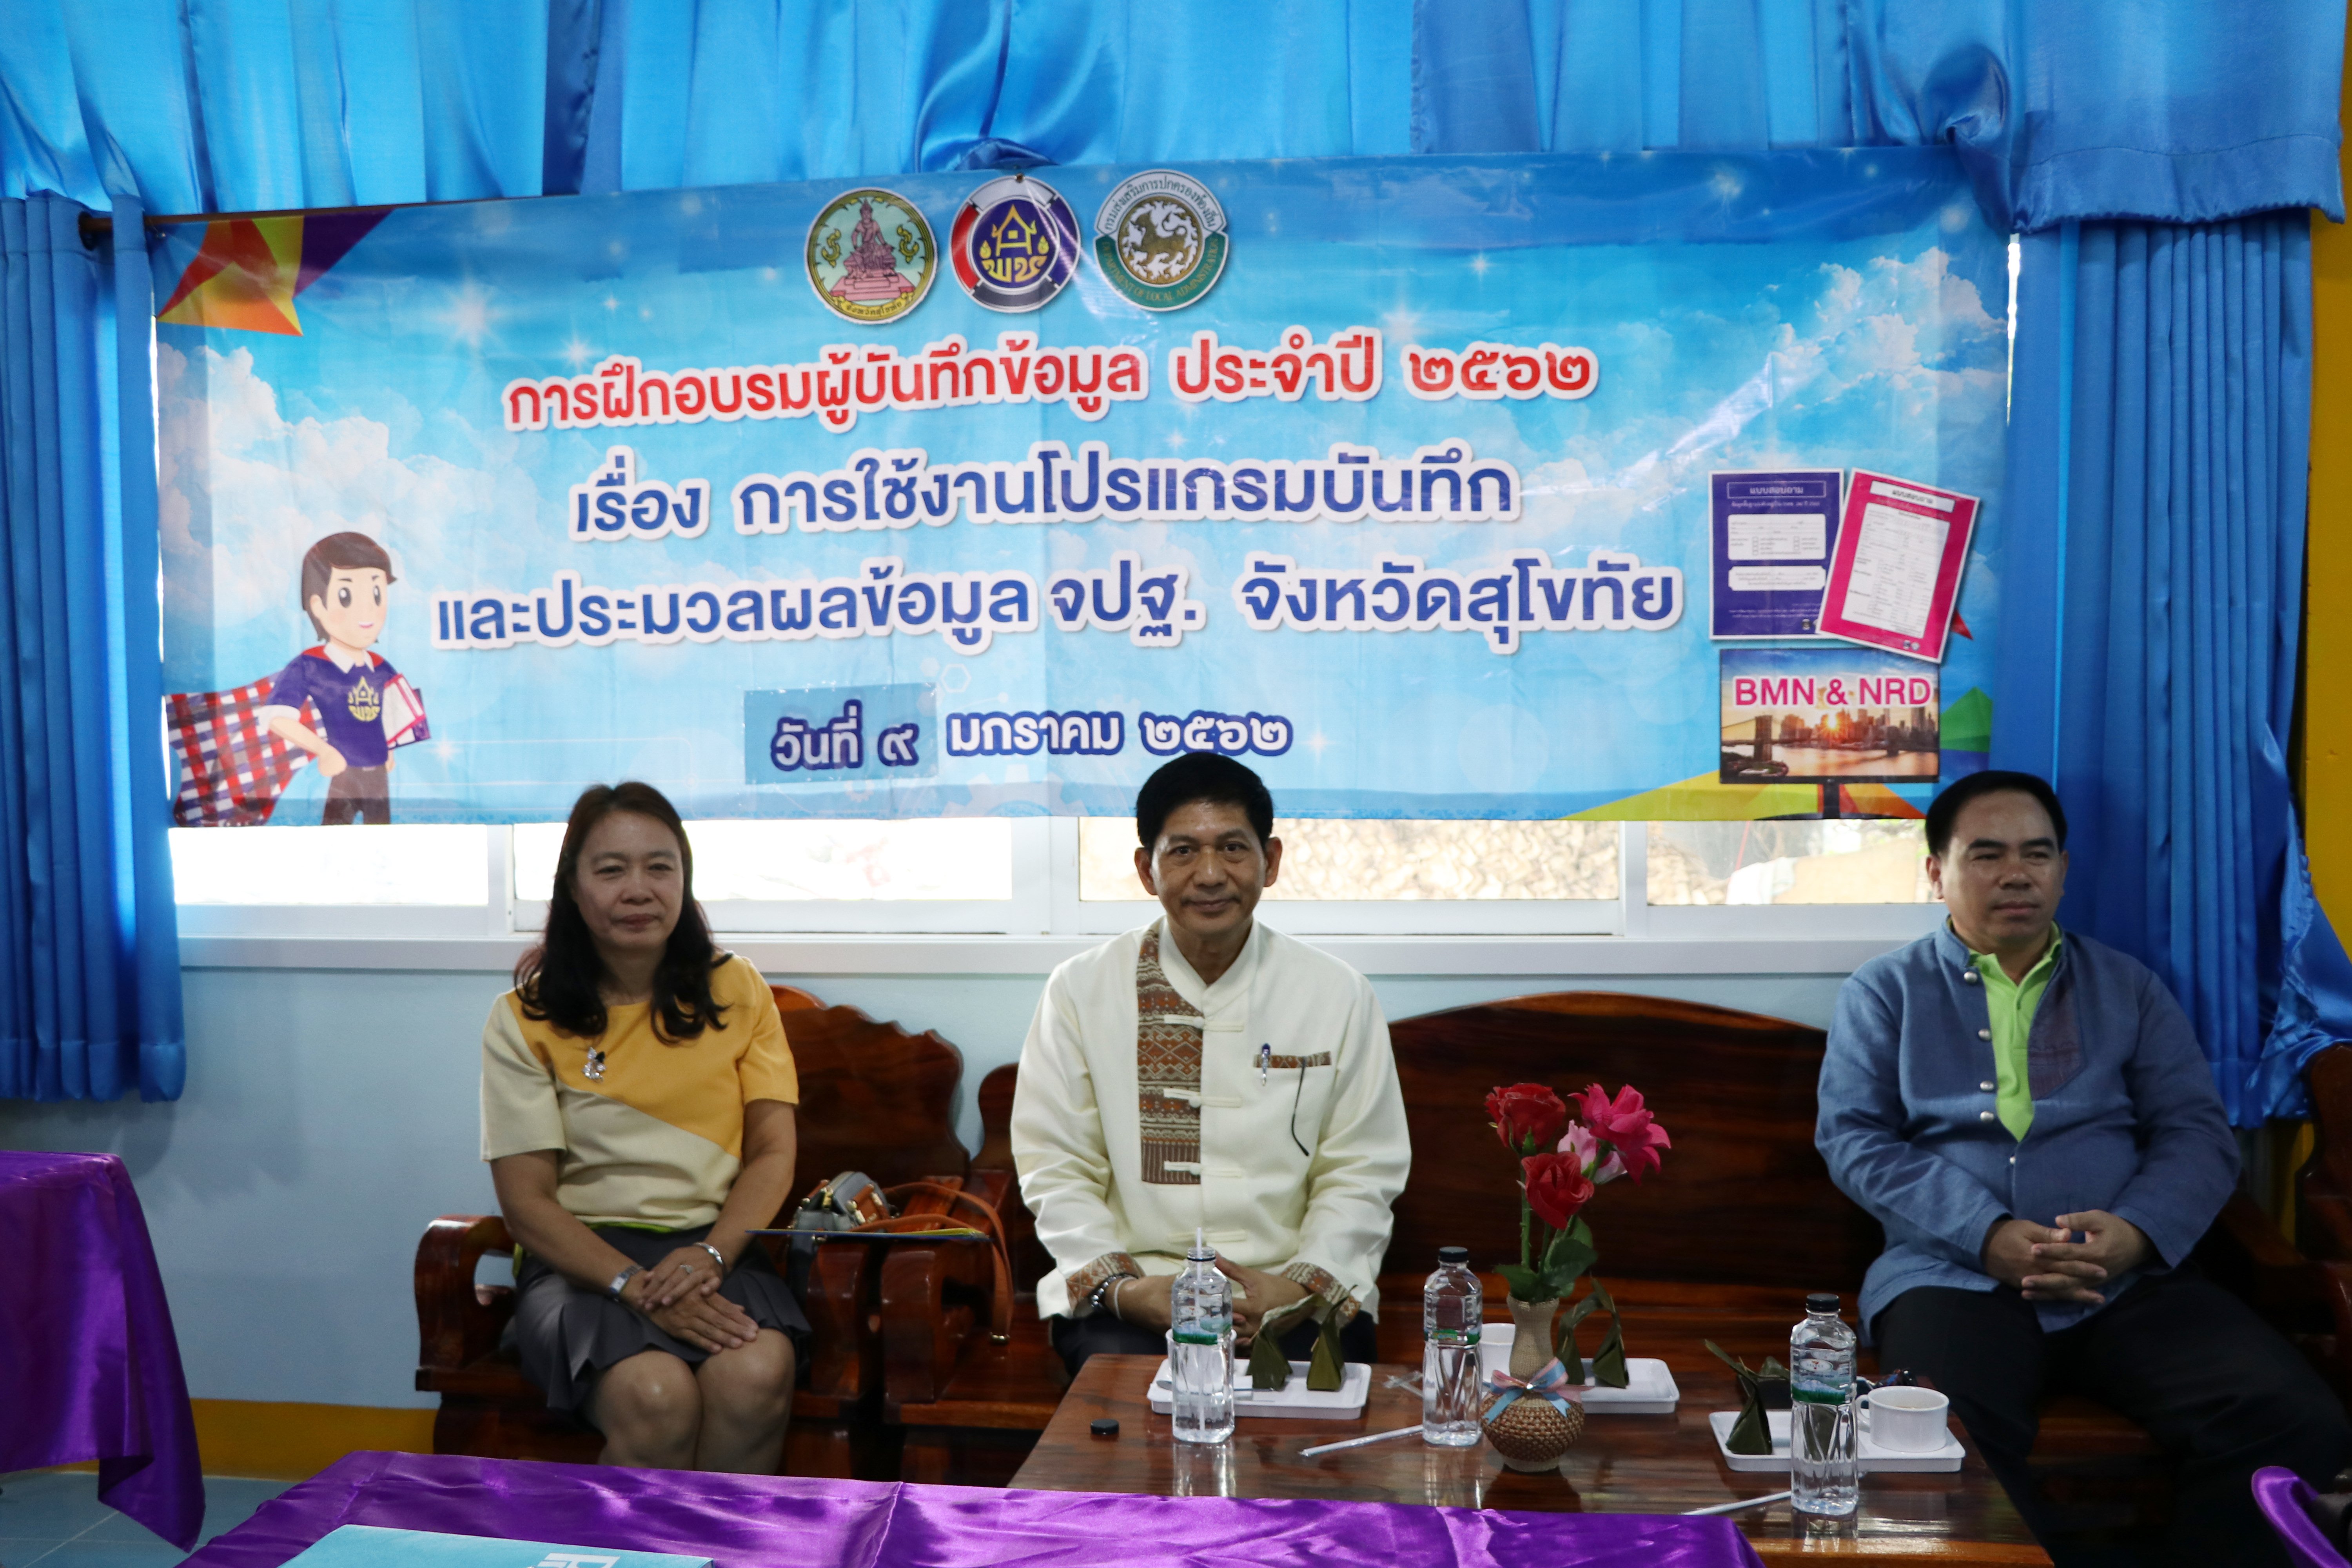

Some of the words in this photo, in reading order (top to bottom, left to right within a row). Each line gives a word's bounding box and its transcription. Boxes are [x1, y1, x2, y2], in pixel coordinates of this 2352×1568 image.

[510, 340, 1140, 425] การฝึกอบรมผู้บันทึกข้อมูล
[1177, 334, 1374, 394] ประจำปี
[1409, 350, 1590, 391] ๒๕๖๒
[575, 455, 701, 532] เรื่อง
[739, 449, 1511, 526] การใช้งานโปรแกรมบันทึก
[438, 565, 1029, 645] และประมวลผลข้อมูล
[1050, 561, 1196, 637] จปฐ.
[1241, 559, 1673, 645] จังหวัดสุโขทัย
[1736, 679, 1814, 705] BMN
[1826, 679, 1848, 705] &
[1860, 679, 1931, 705] NRD
[777, 706, 858, 765] วันที่
[883, 729, 914, 760] ๙
[951, 717, 1120, 751] มกราคม
[1142, 716, 1288, 751] ๒๕๖๒
